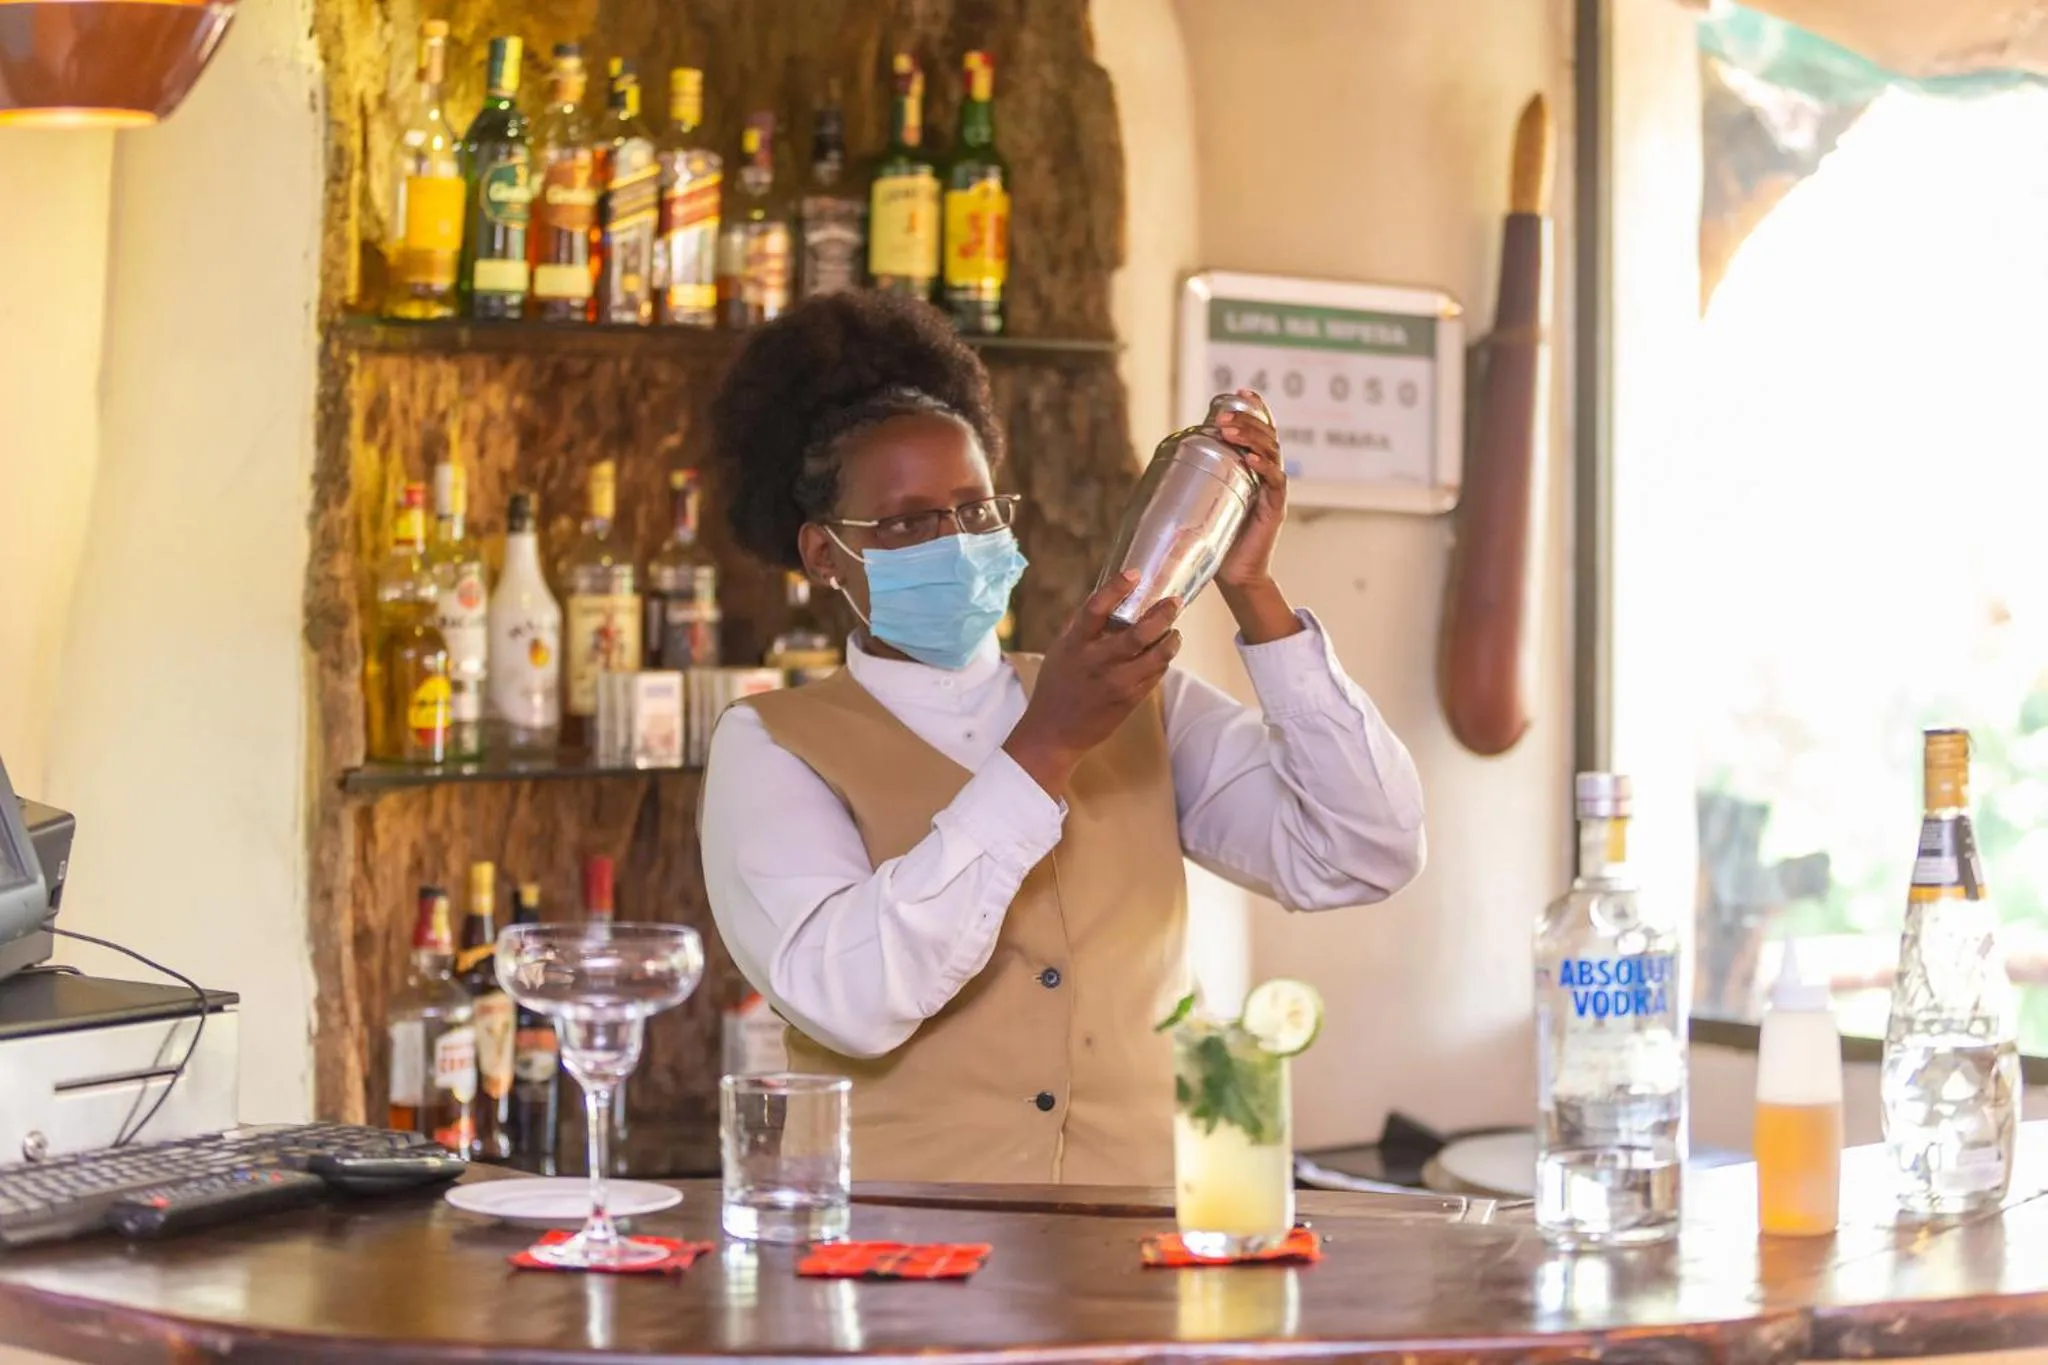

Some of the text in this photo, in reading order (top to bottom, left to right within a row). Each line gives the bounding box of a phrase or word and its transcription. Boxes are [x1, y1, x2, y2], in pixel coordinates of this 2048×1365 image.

[1224, 309, 1279, 335] LIPA
[1284, 316, 1319, 338] NA
[1573, 988, 1667, 1018] VODKA
